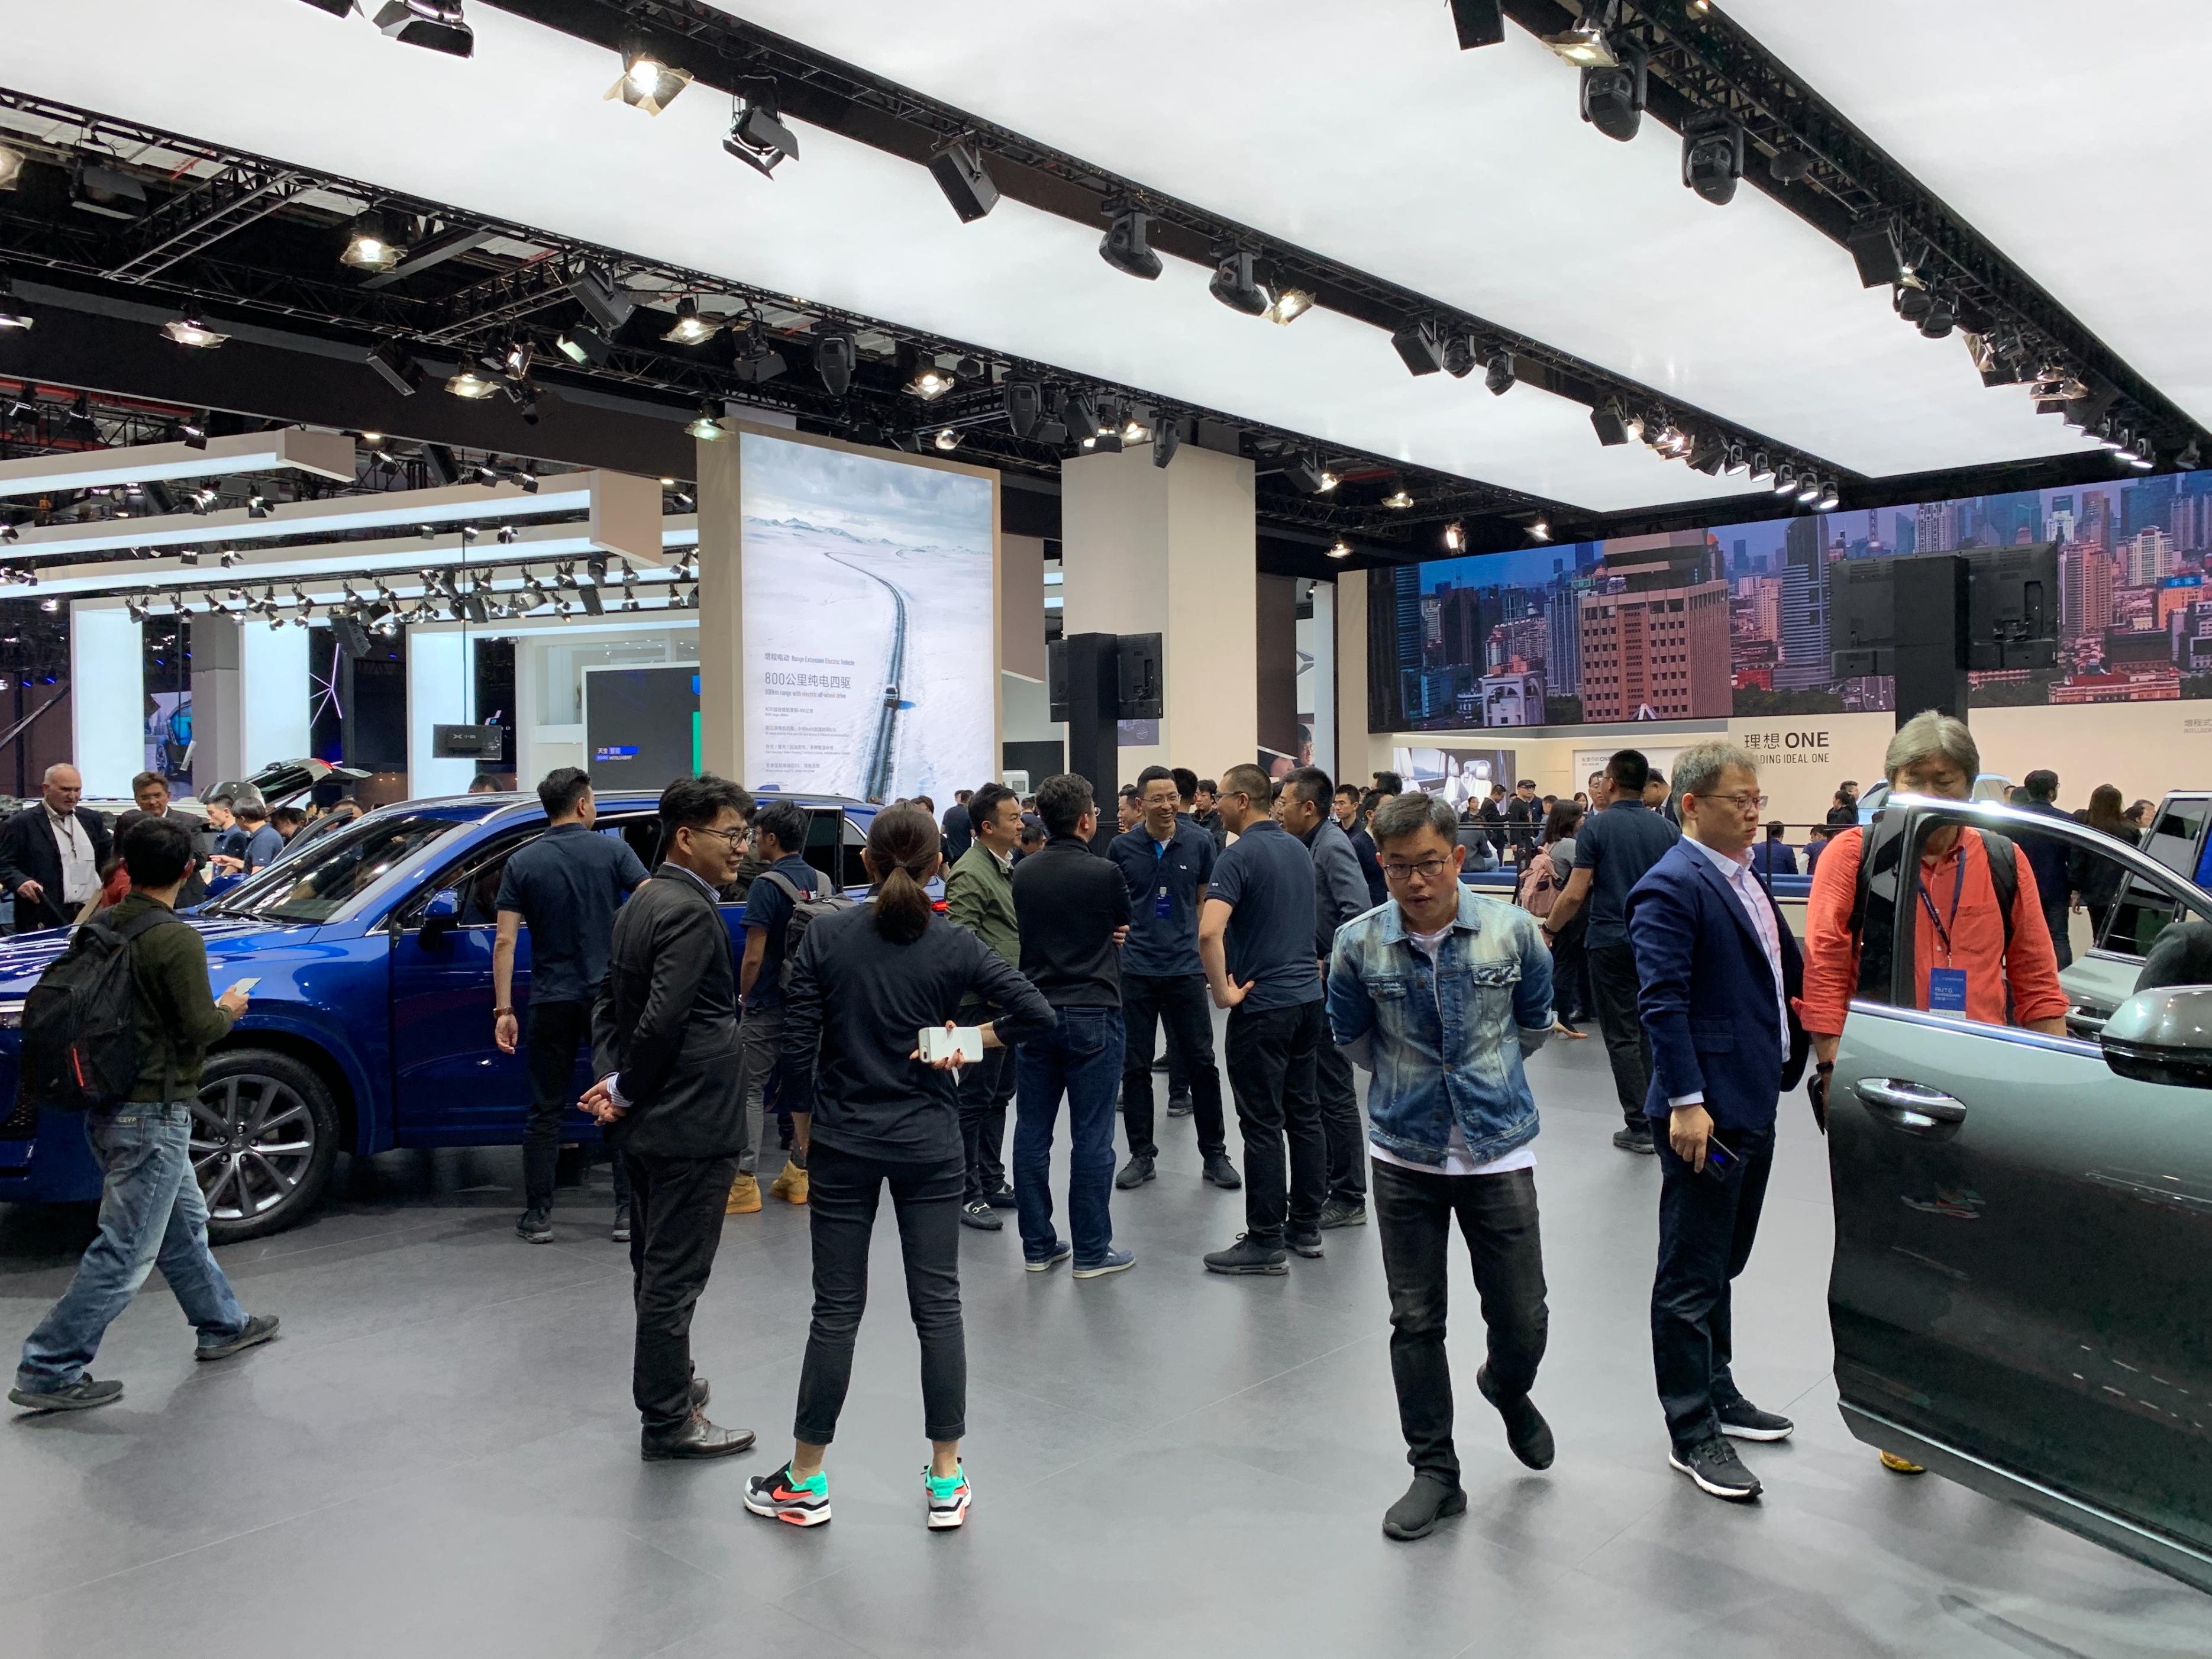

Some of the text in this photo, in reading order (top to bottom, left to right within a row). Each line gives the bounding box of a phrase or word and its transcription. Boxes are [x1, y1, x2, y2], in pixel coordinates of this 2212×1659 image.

[765, 672, 851, 689] 800公里纯电四驱
[1744, 731, 1829, 749] 理想 ONE
[1783, 753, 1808, 763] IDEAL
[1811, 753, 1829, 763] ONE
